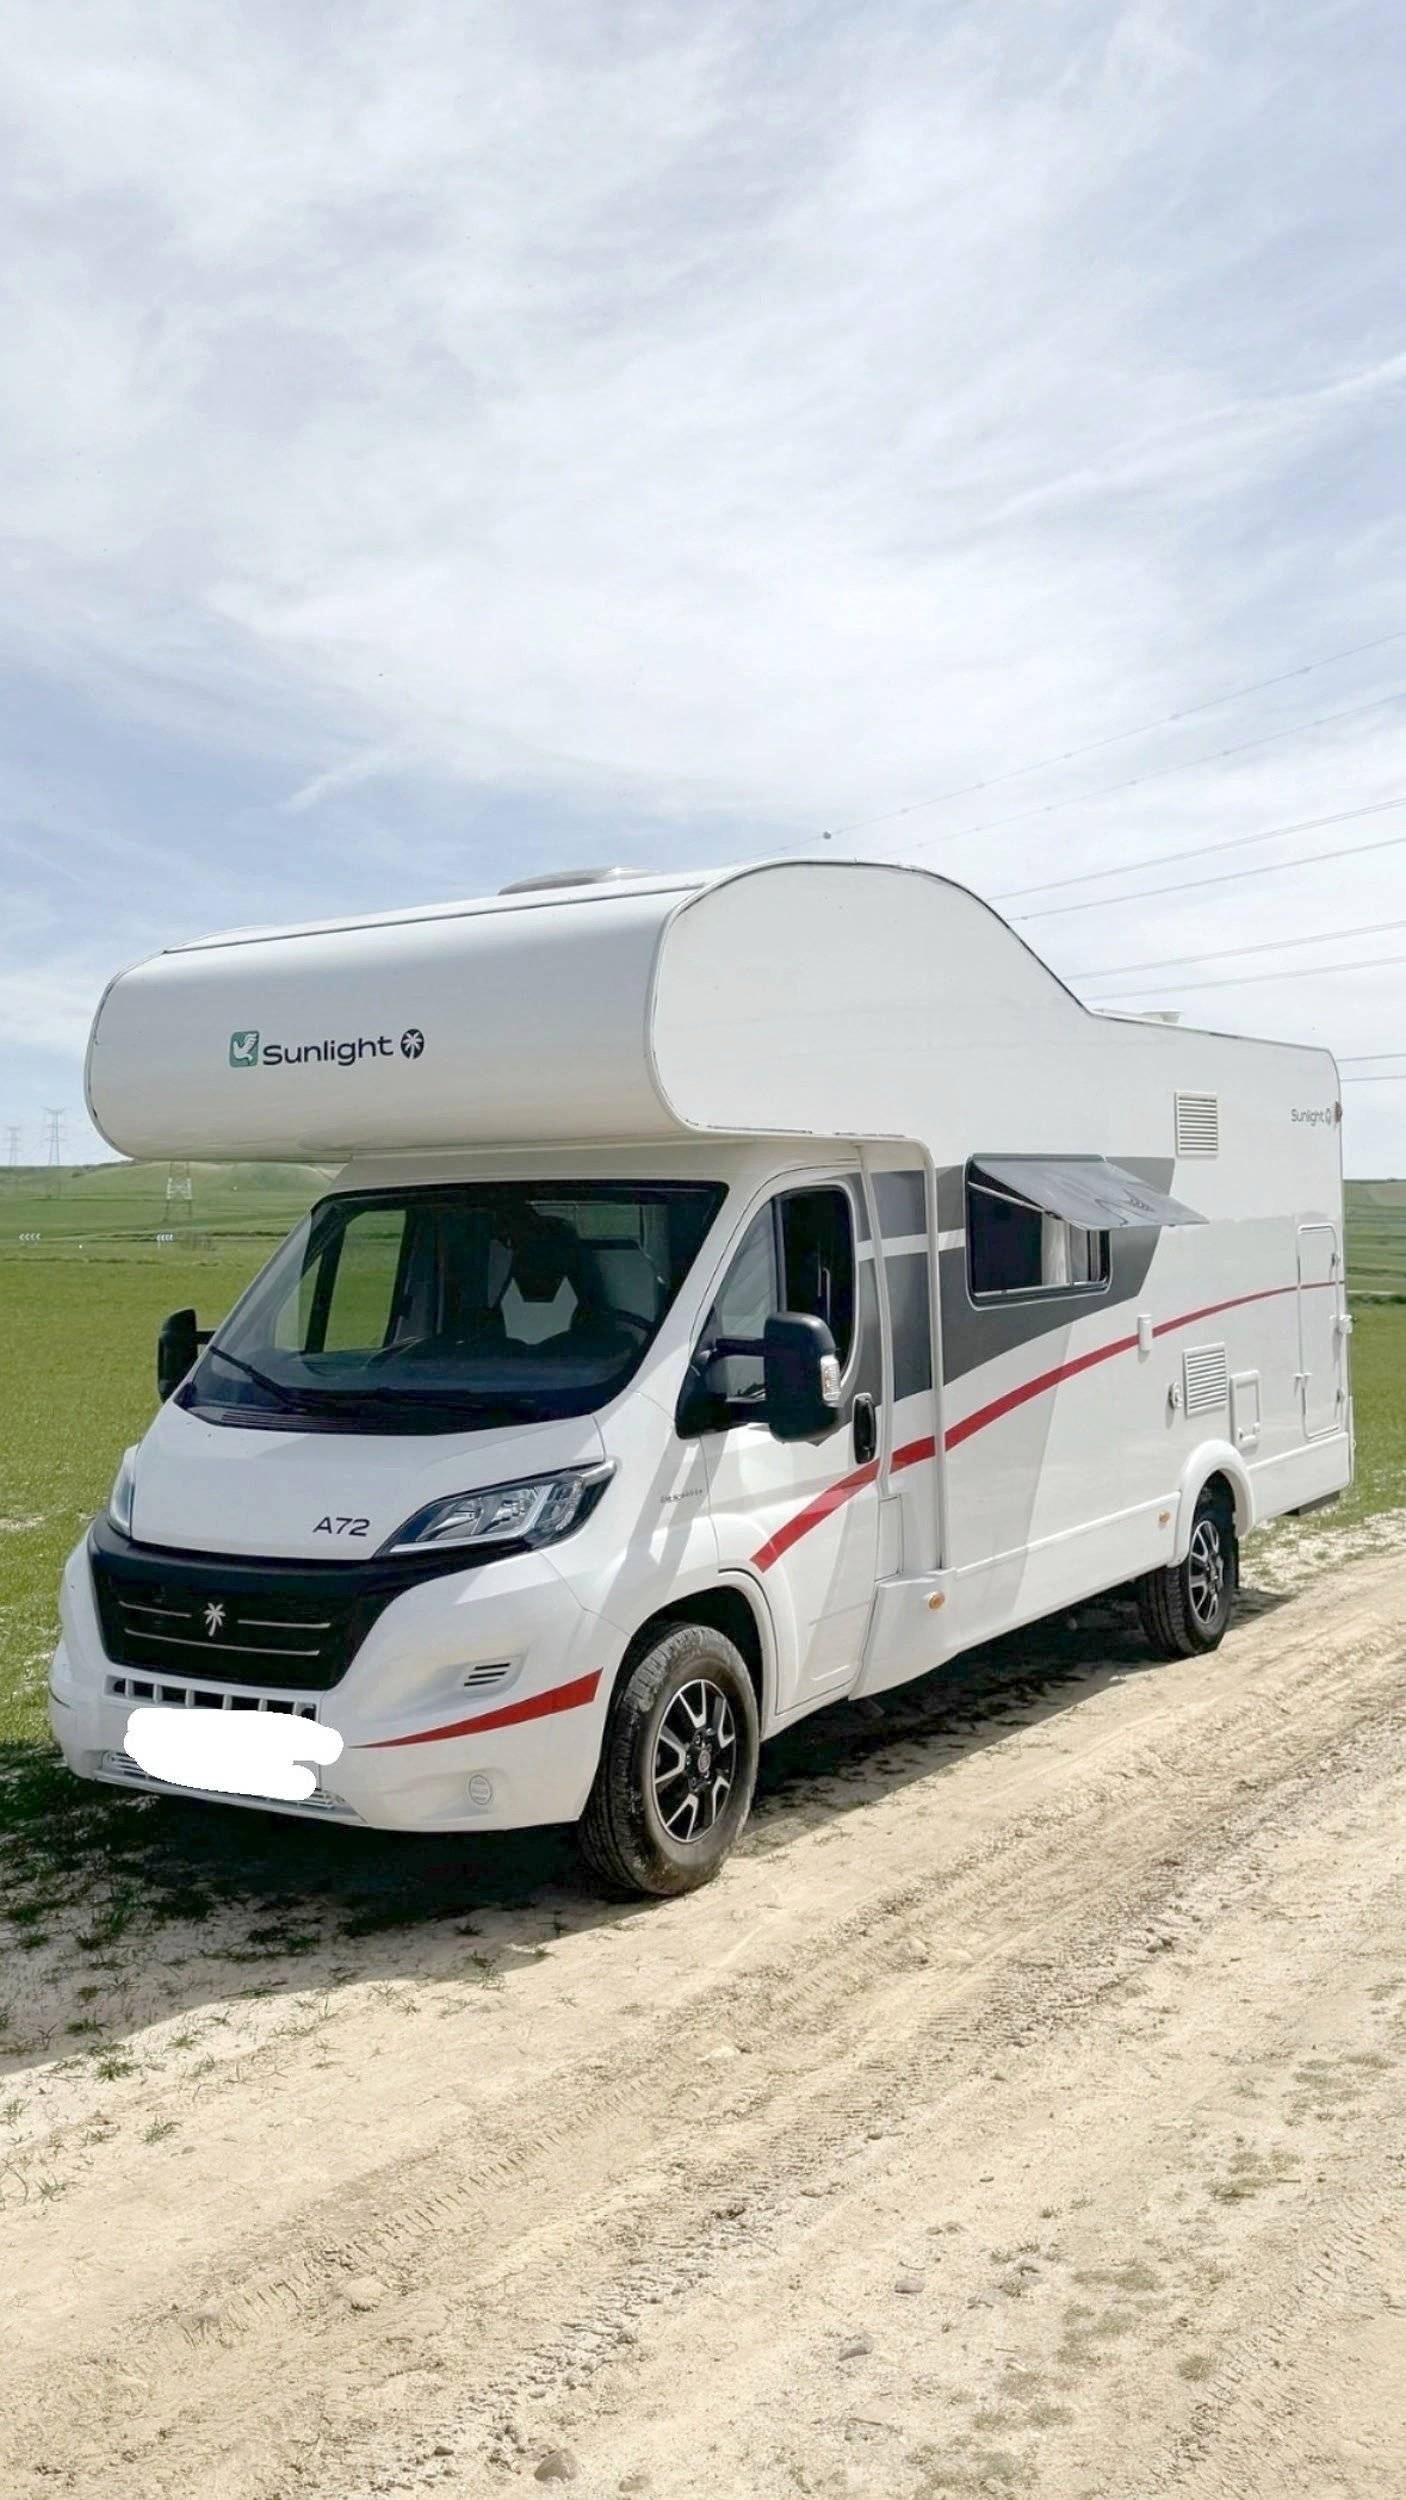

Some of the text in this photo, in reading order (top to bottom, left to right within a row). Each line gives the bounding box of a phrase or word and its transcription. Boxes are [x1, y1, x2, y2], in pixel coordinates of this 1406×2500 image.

[262, 1036, 394, 1066] Sunlight
[1290, 1108, 1325, 1127] Sunlight
[312, 1516, 370, 1537] A72
